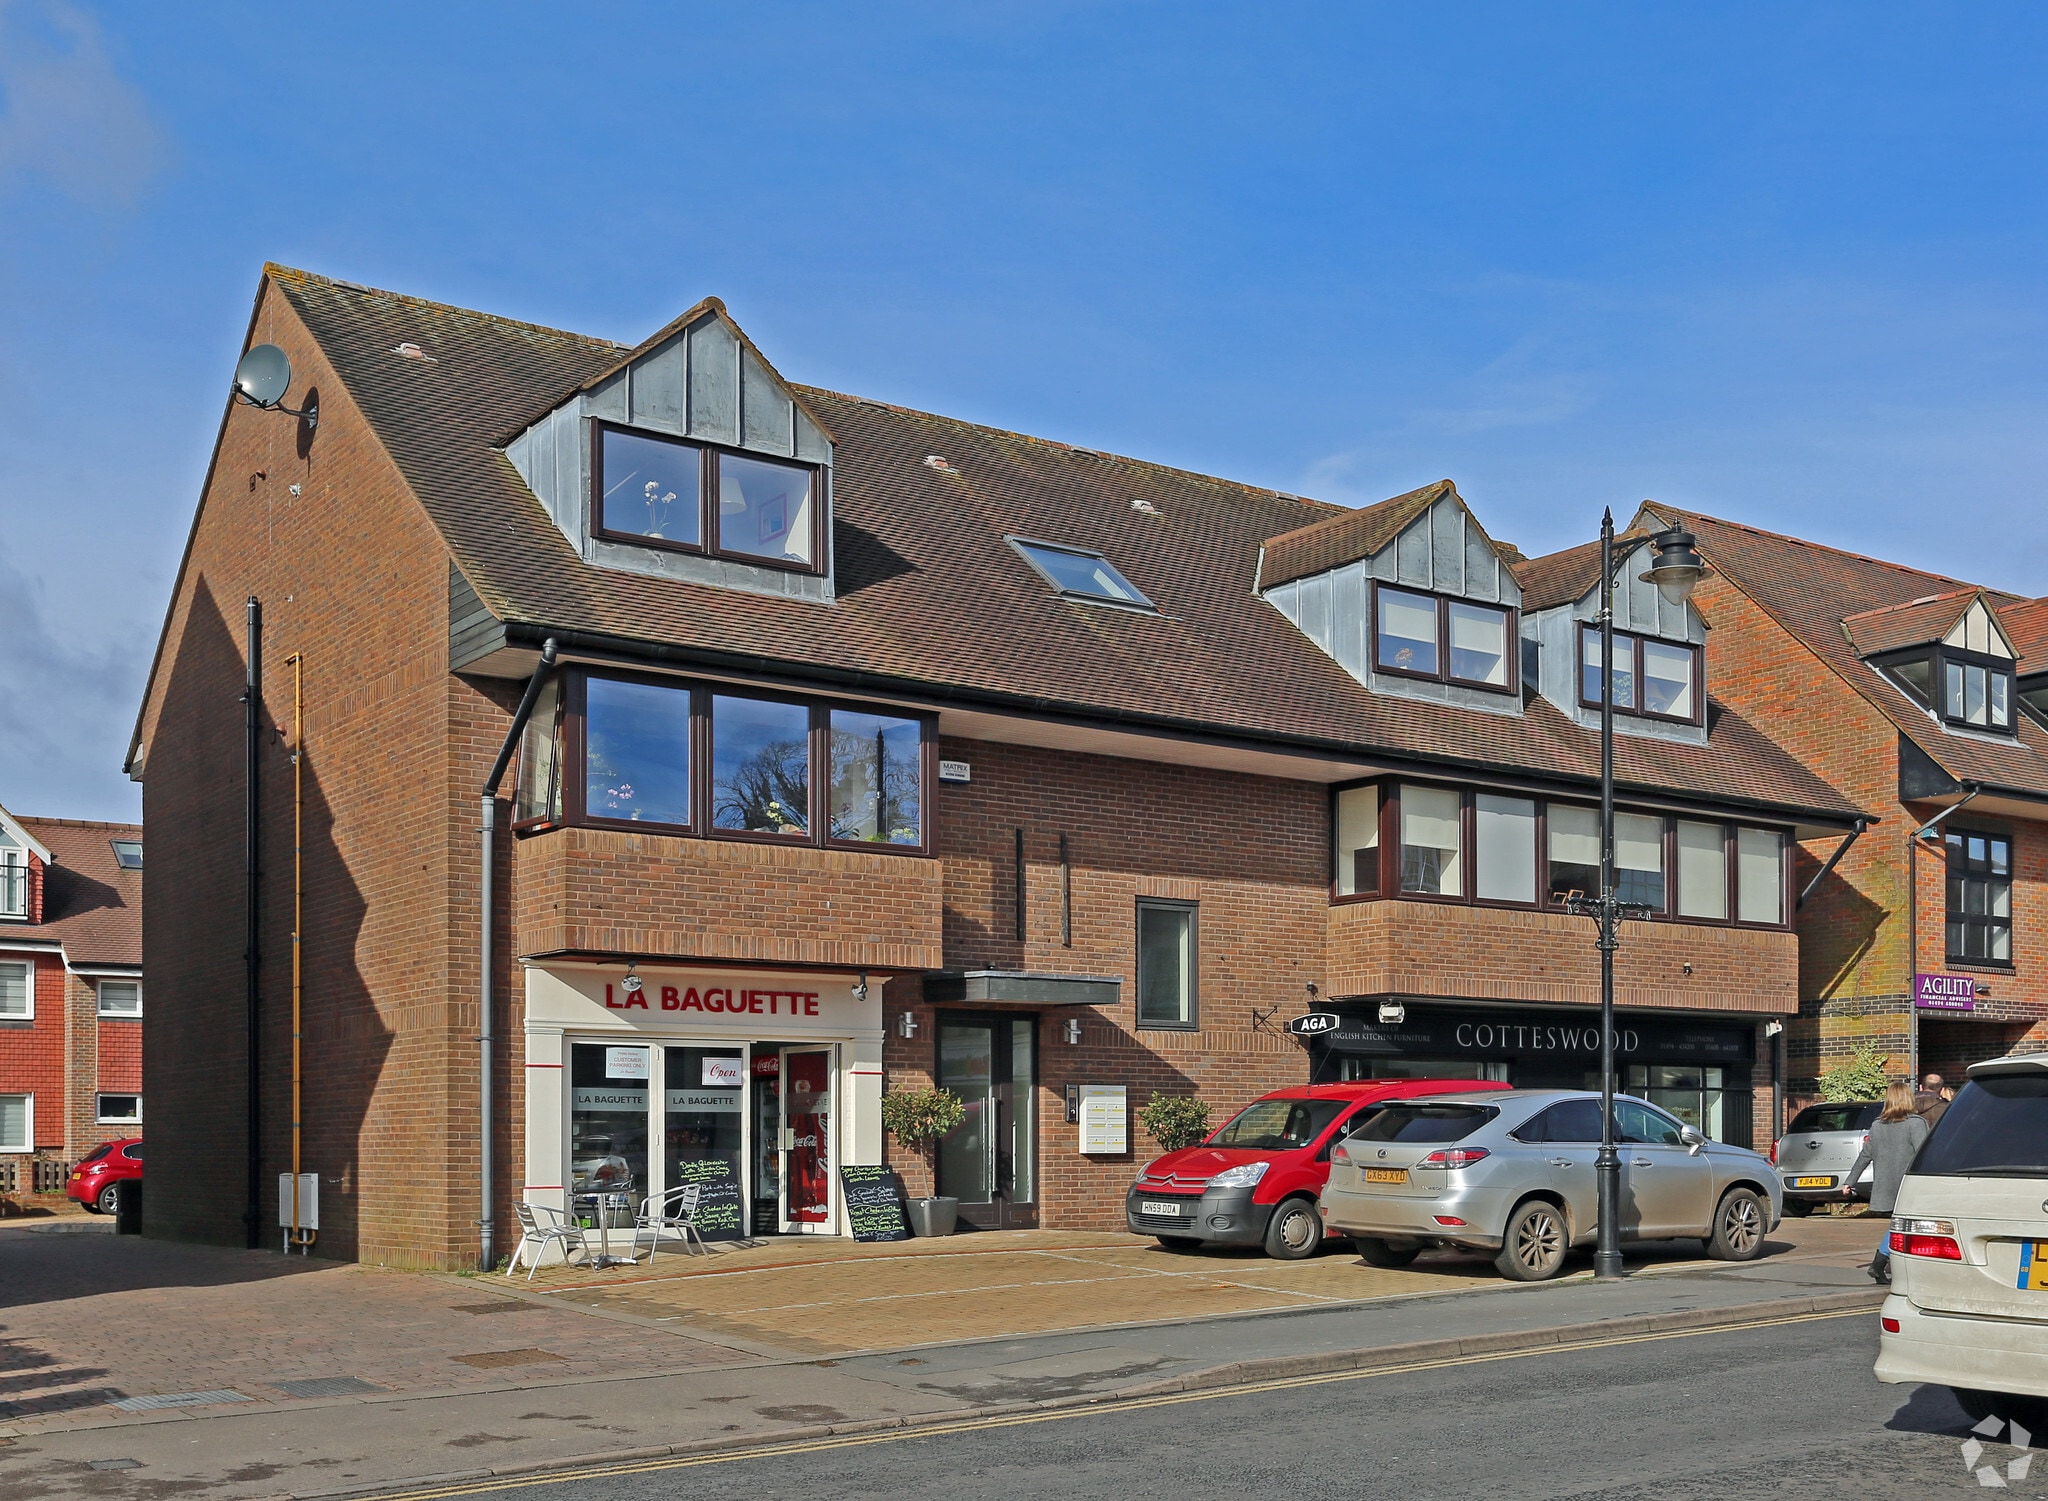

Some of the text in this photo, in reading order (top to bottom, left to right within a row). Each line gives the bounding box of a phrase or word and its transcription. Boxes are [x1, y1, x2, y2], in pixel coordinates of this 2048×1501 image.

[1922, 976, 1972, 996] AGILITY
[606, 984, 819, 1016] LA BAGUETTE
[1300, 1017, 1327, 1031] AGA
[1330, 1032, 1431, 1042] ENGLISH KITCHEN FURNITURE
[710, 1063, 737, 1080] Open
[578, 1096, 643, 1104] LA BAGUETTE
[1367, 1170, 1405, 1181] GX63 XYD
